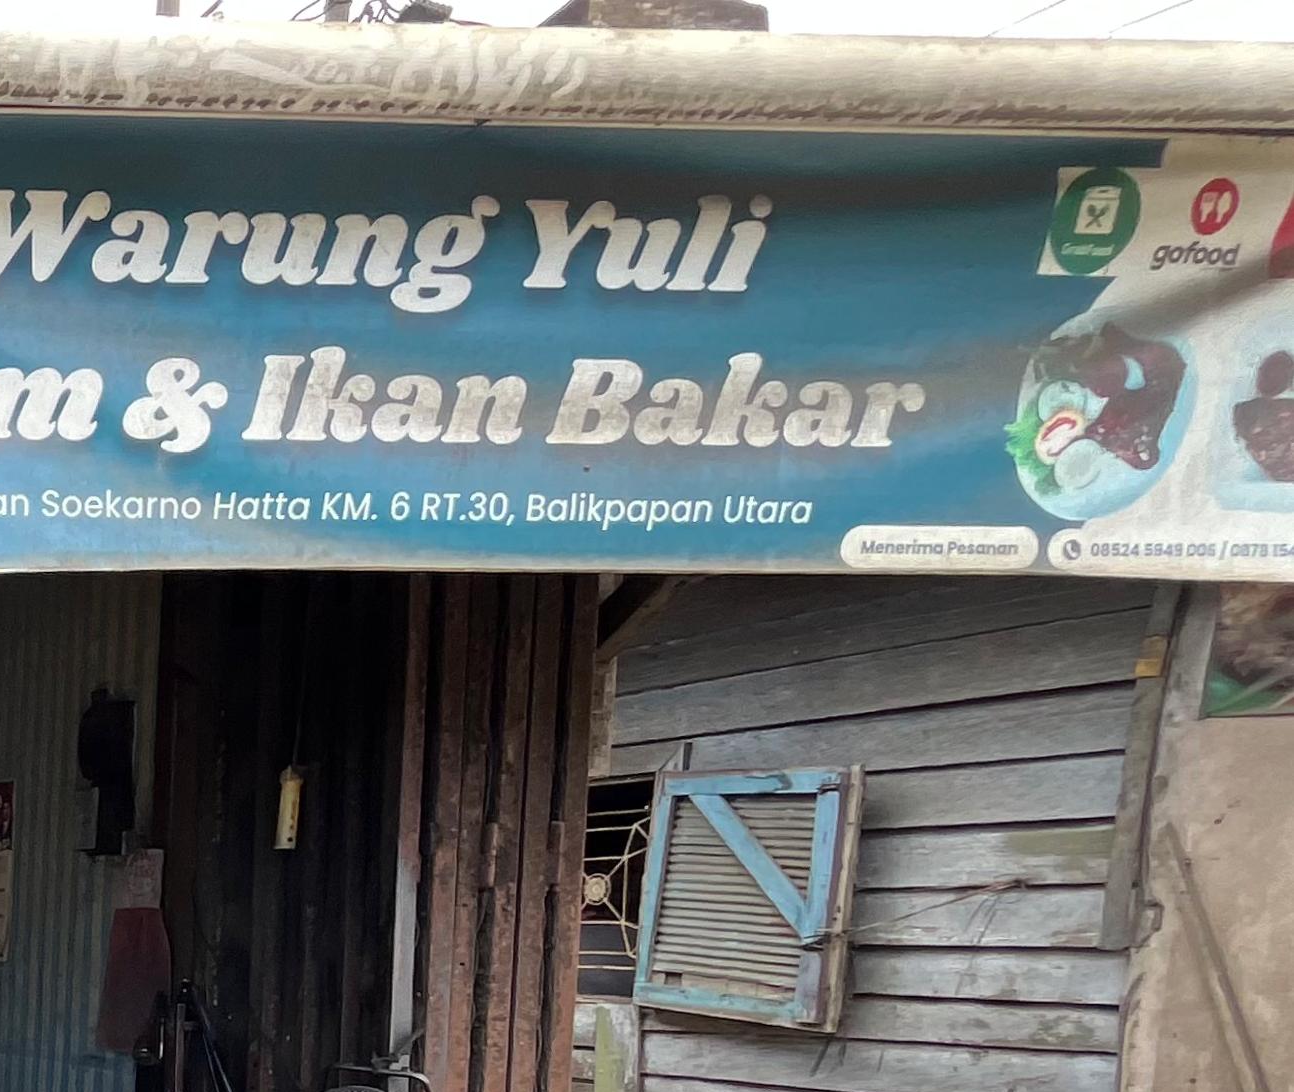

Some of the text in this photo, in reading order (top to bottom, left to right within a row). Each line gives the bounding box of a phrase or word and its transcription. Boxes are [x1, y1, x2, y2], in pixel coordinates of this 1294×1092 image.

[524, 195, 773, 292] Yuli
[1150, 241, 1240, 270] gofood
[122, 357, 228, 453] &
[241, 346, 527, 443] Ikan
[545, 352, 925, 447] Bakar
[41, 488, 201, 521] Soekarno
[213, 491, 310, 521] Hatta
[321, 493, 378, 521] KM.
[390, 491, 410, 521] 6
[421, 492, 515, 526] RT.30,
[526, 491, 712, 532] Balikpapan
[723, 494, 813, 525] Utara
[861, 539, 1019, 556] Menerima Pesanan
